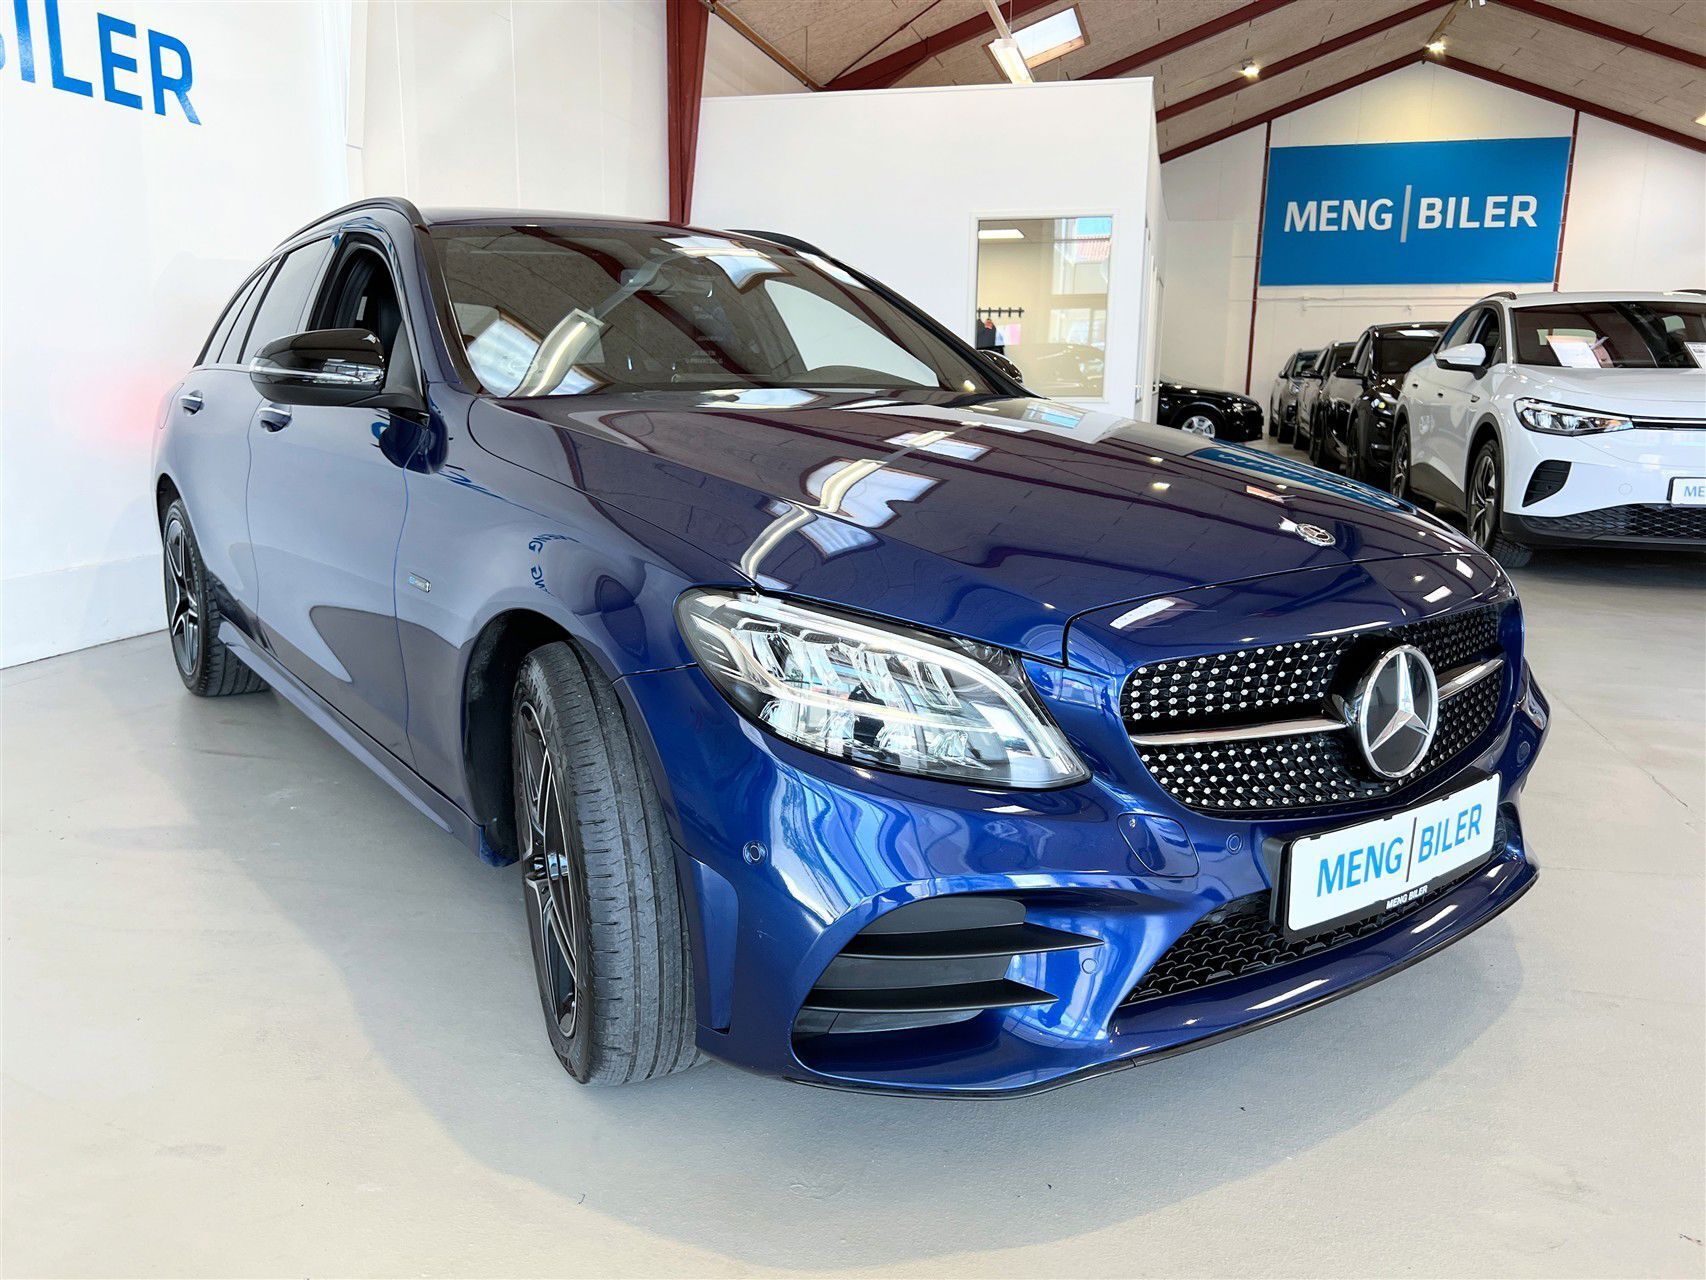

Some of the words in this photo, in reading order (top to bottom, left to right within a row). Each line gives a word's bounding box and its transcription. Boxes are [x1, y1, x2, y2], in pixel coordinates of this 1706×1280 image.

[0, 0, 202, 125] ILER
[1284, 198, 1394, 232] MENG
[1417, 195, 1538, 230] BILER
[1316, 837, 1404, 897] MENG
[1418, 803, 1482, 863] BILER
